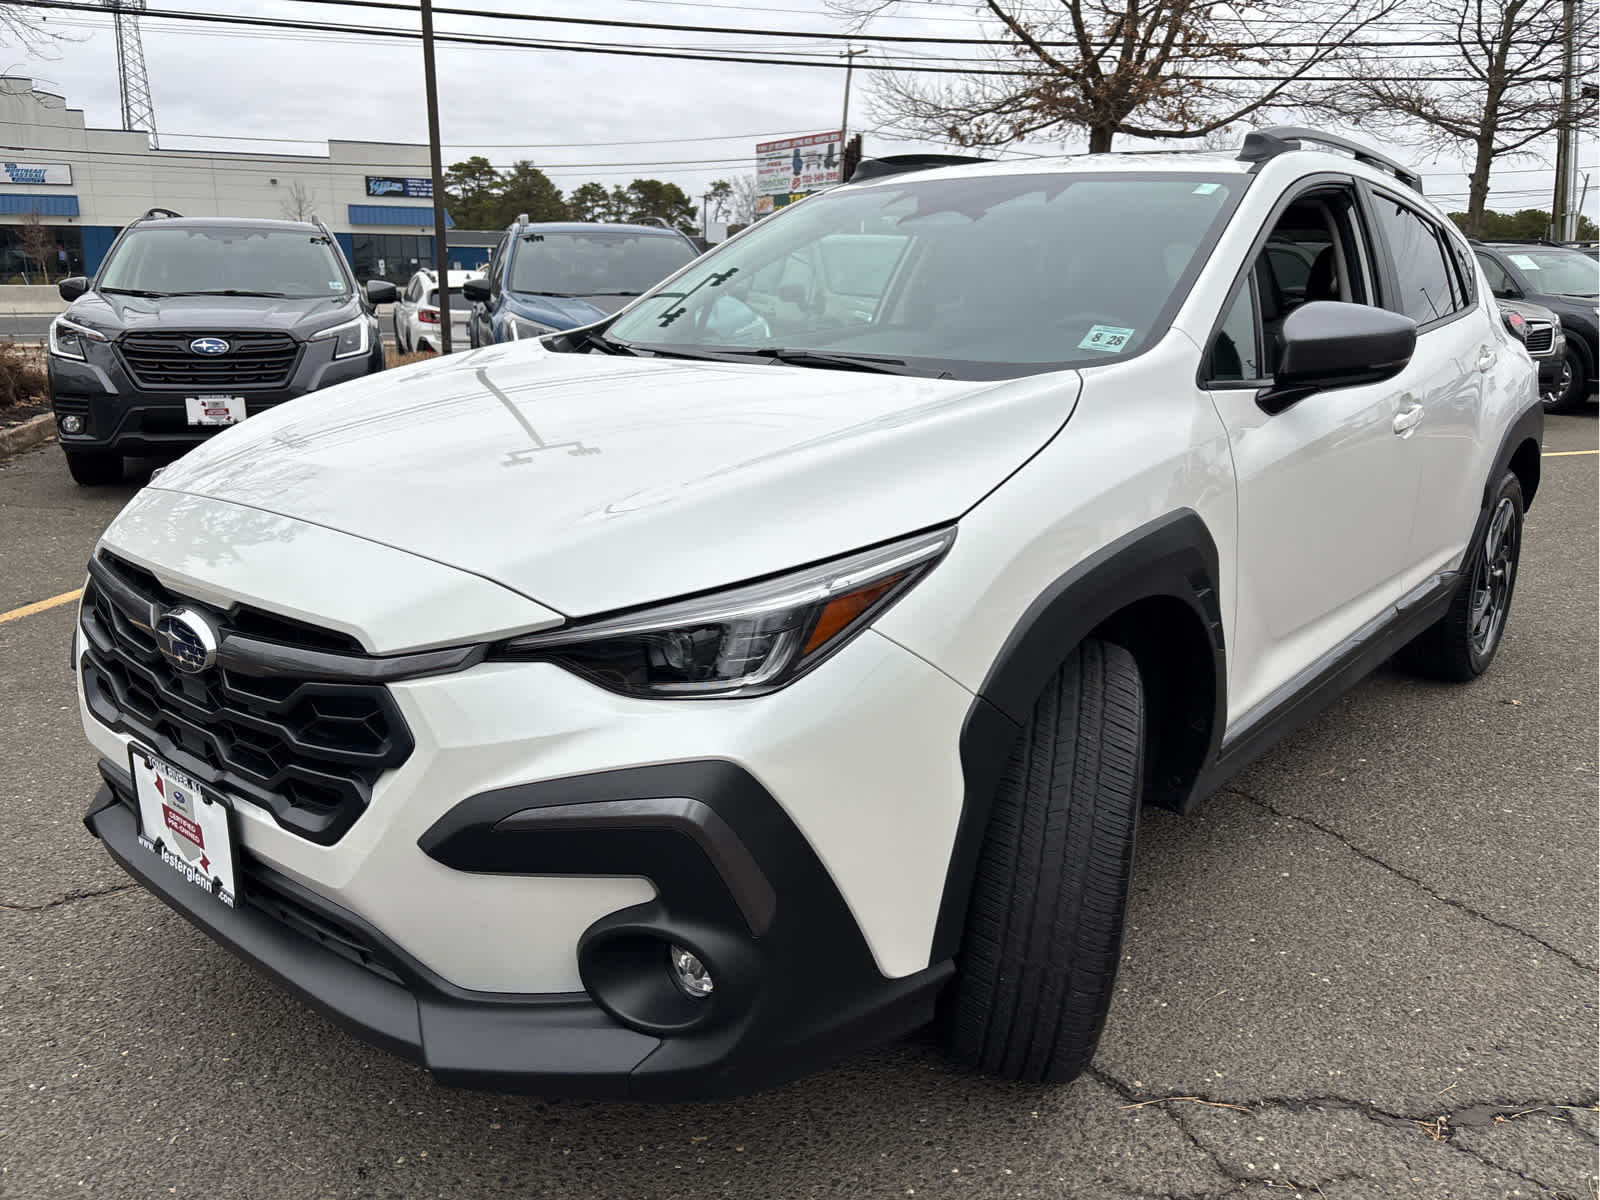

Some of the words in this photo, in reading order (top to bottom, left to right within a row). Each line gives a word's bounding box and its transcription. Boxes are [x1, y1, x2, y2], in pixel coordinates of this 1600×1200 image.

[1092, 332, 1103, 342] 8
[1105, 335, 1124, 346] 28
[167, 816, 201, 844] PRE-OWNED
[168, 810, 197, 833] CERTIFIED
[161, 846, 212, 894] lesterglenn
